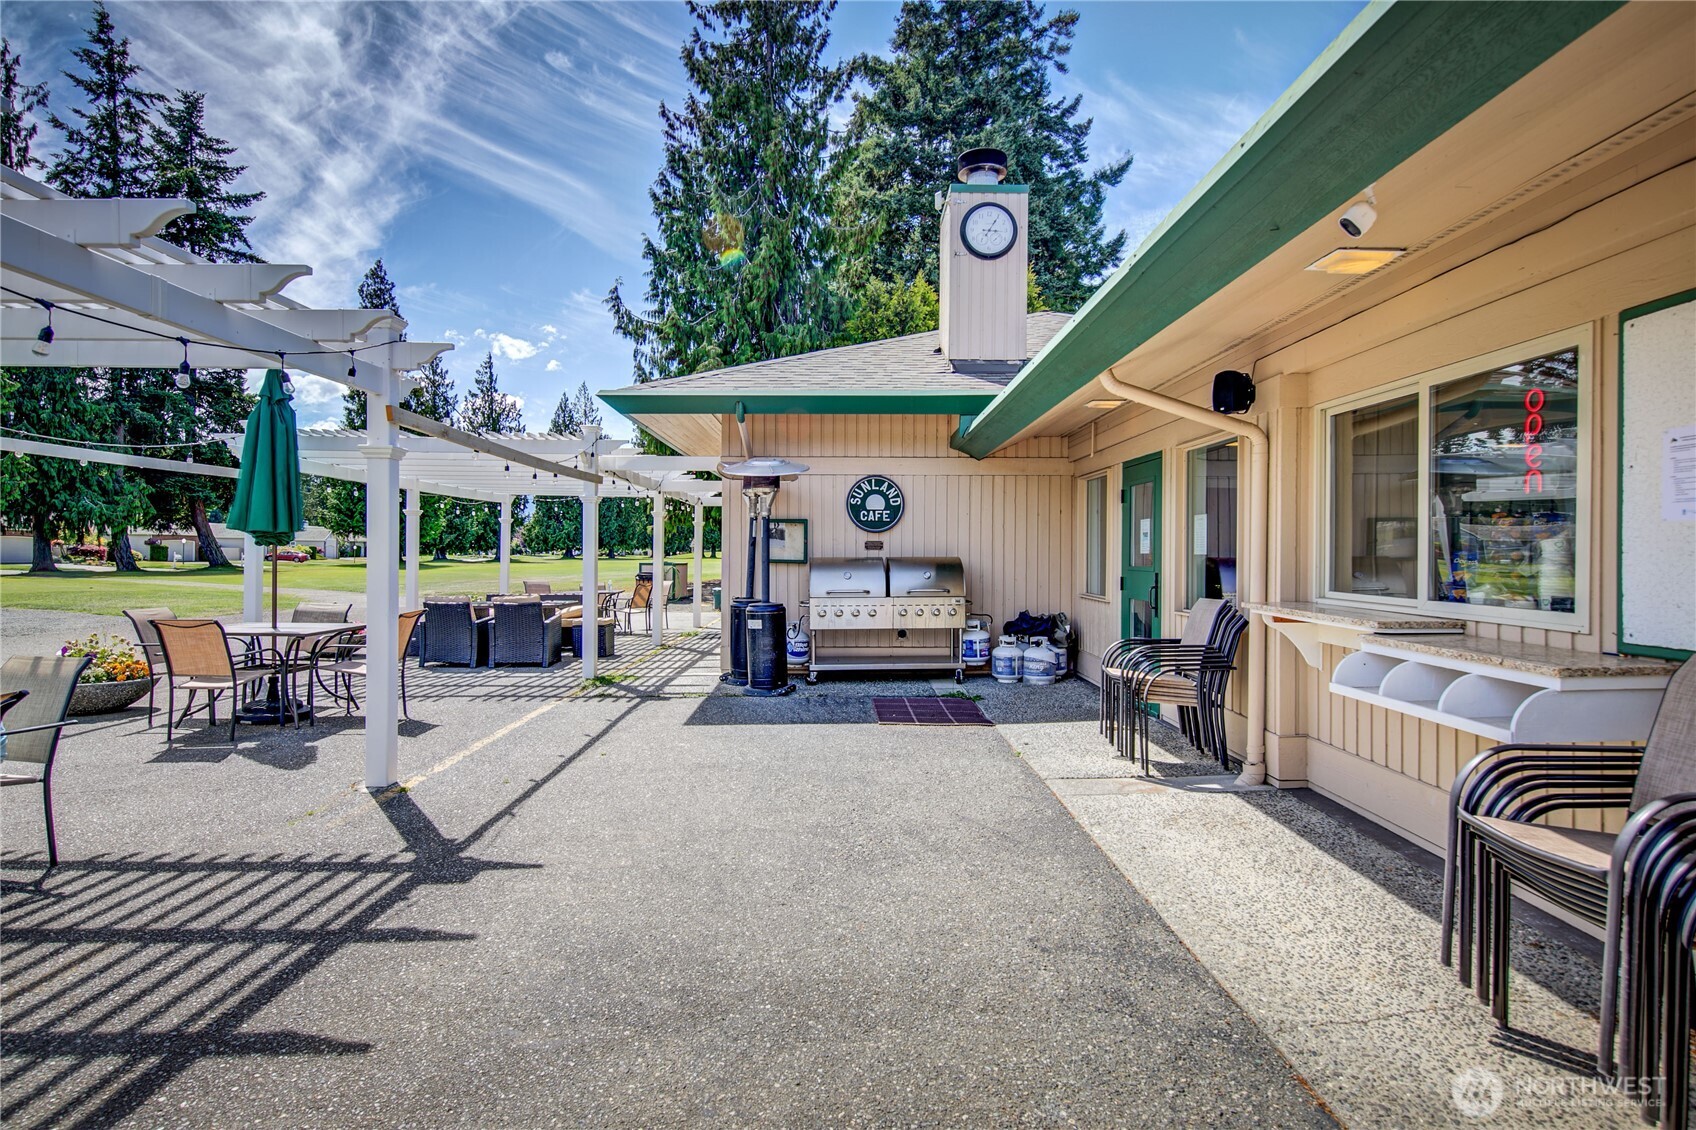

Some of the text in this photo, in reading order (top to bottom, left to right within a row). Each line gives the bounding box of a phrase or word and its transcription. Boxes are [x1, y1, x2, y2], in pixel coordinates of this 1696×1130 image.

[1524, 388, 1545, 494] open
[850, 479, 901, 506] SUNLAND
[860, 510, 890, 522] CAFE
